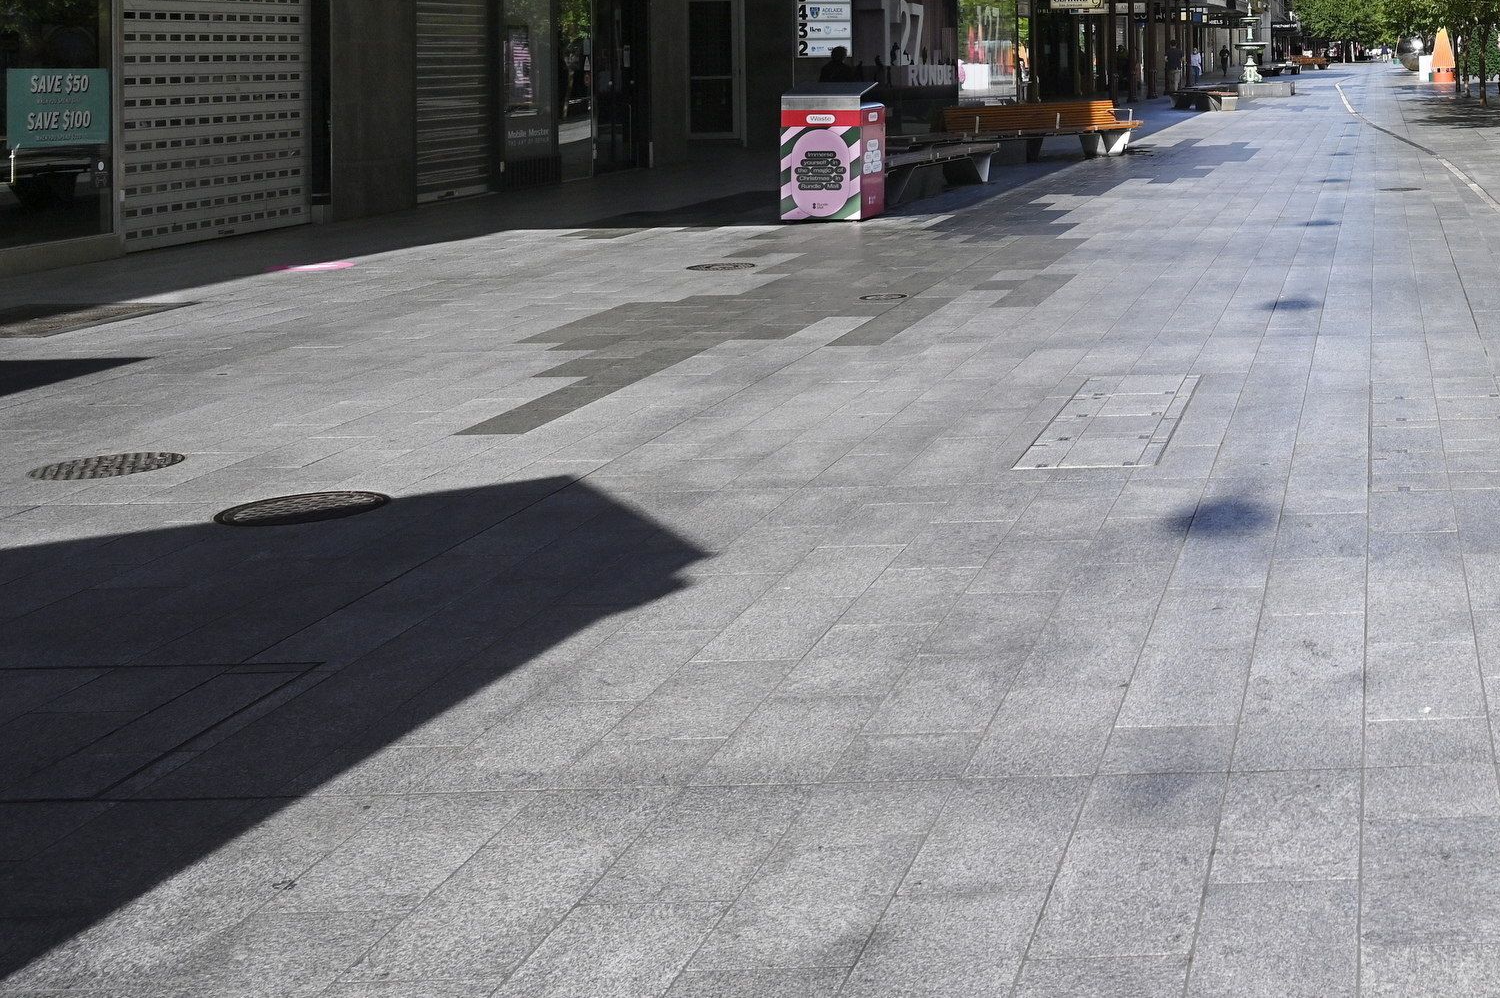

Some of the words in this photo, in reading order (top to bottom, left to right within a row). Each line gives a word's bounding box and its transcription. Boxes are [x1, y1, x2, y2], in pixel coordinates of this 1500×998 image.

[798, 4, 808, 20] 4
[798, 22, 808, 39] 3
[798, 40, 808, 56] 2
[30, 74, 63, 94] SAVE
[65, 73, 90, 95] $50
[908, 64, 953, 86] RUNDLE
[27, 111, 60, 131] SAVE
[63, 110, 92, 131] $100
